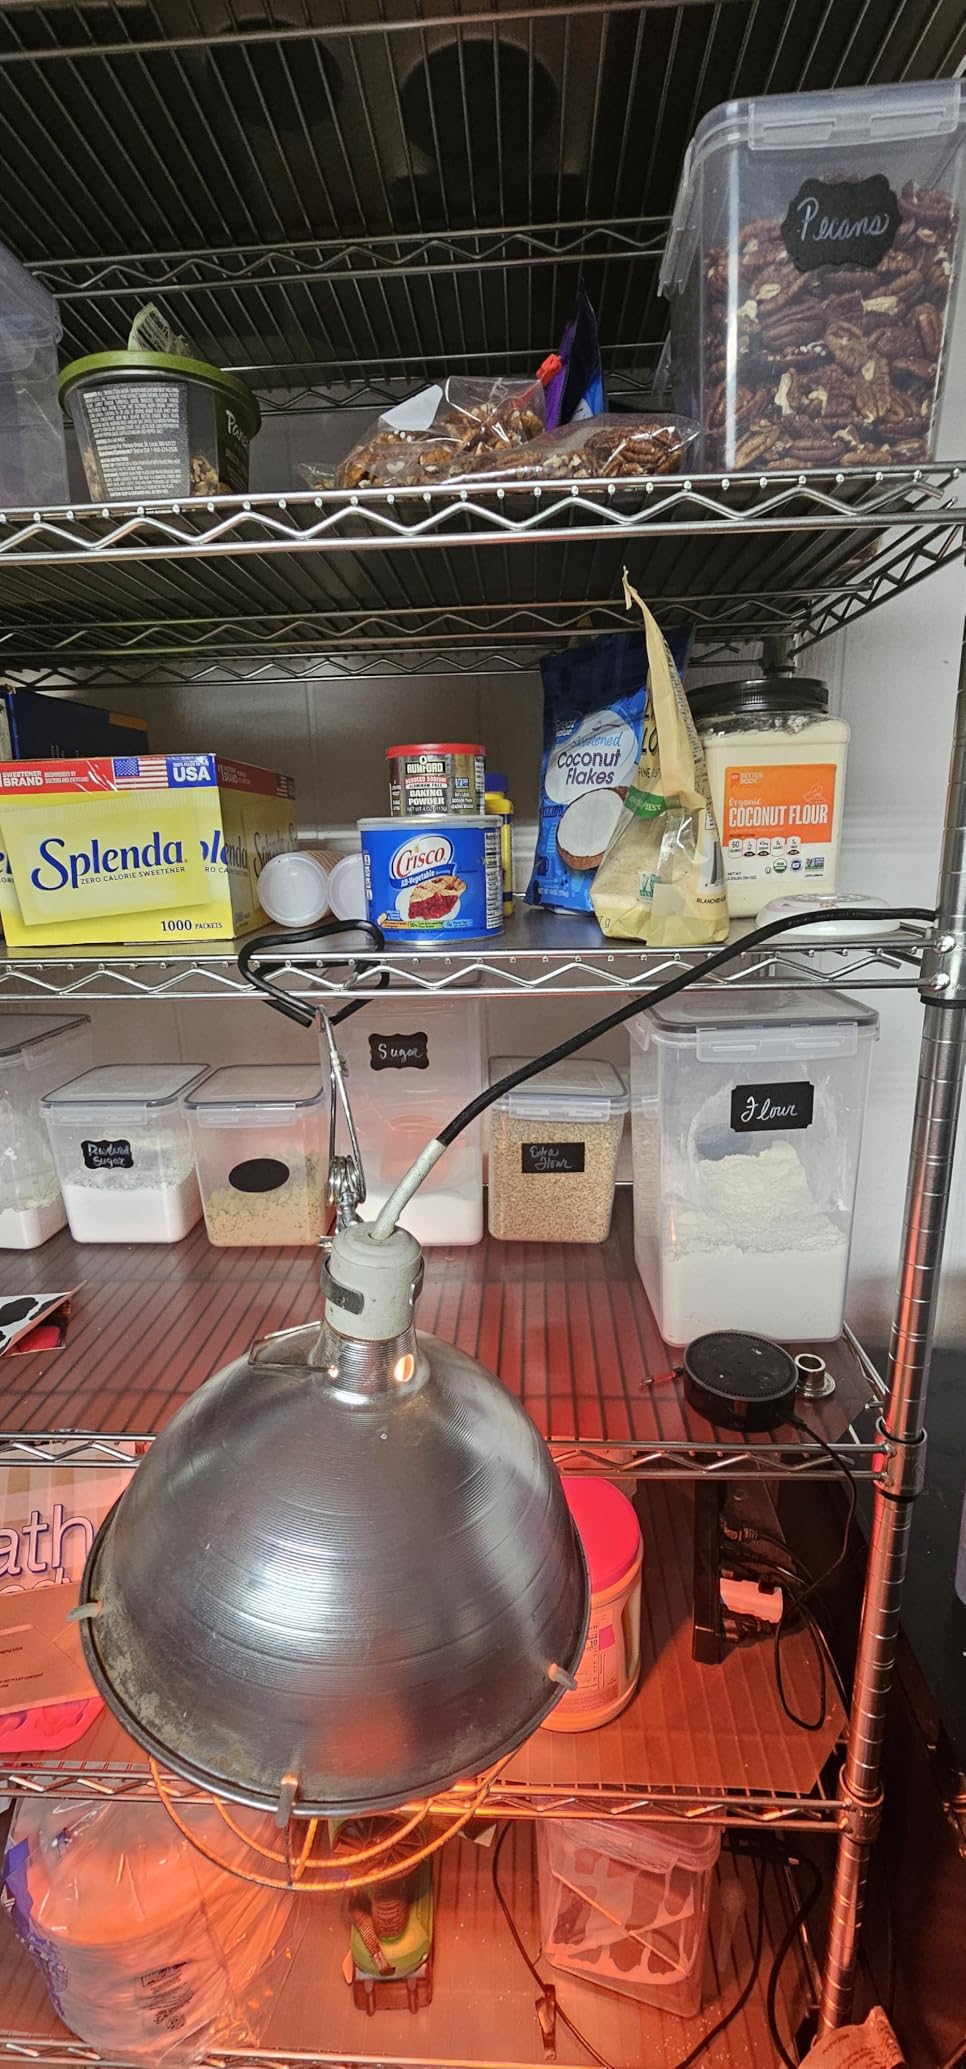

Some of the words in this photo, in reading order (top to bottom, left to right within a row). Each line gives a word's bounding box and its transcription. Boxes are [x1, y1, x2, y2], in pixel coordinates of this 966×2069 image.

[796, 196, 890, 241] Pecans
[407, 761, 444, 774] RUMFORD
[557, 748, 621, 769] Coconut
[2, 770, 42, 780] SWEETENER
[3, 776, 43, 787] BRAND
[172, 766, 211, 783] USA
[565, 768, 615, 785] Flakes
[408, 797, 445, 806] POWDER
[409, 789, 443, 797] BAKING
[729, 805, 787, 828] COCONUT
[788, 804, 829, 825] FLOUR
[31, 831, 184, 891] Splenda
[396, 846, 446, 878] Crisco
[80, 876, 101, 885] ZERO
[103, 872, 137, 882] CALORIE
[139, 866, 185, 878] SWEETENER
[161, 919, 192, 932] 1000
[195, 922, 223, 930] PACKETS
[378, 1043, 423, 1064] Sugar
[741, 1096, 798, 1123] Flour
